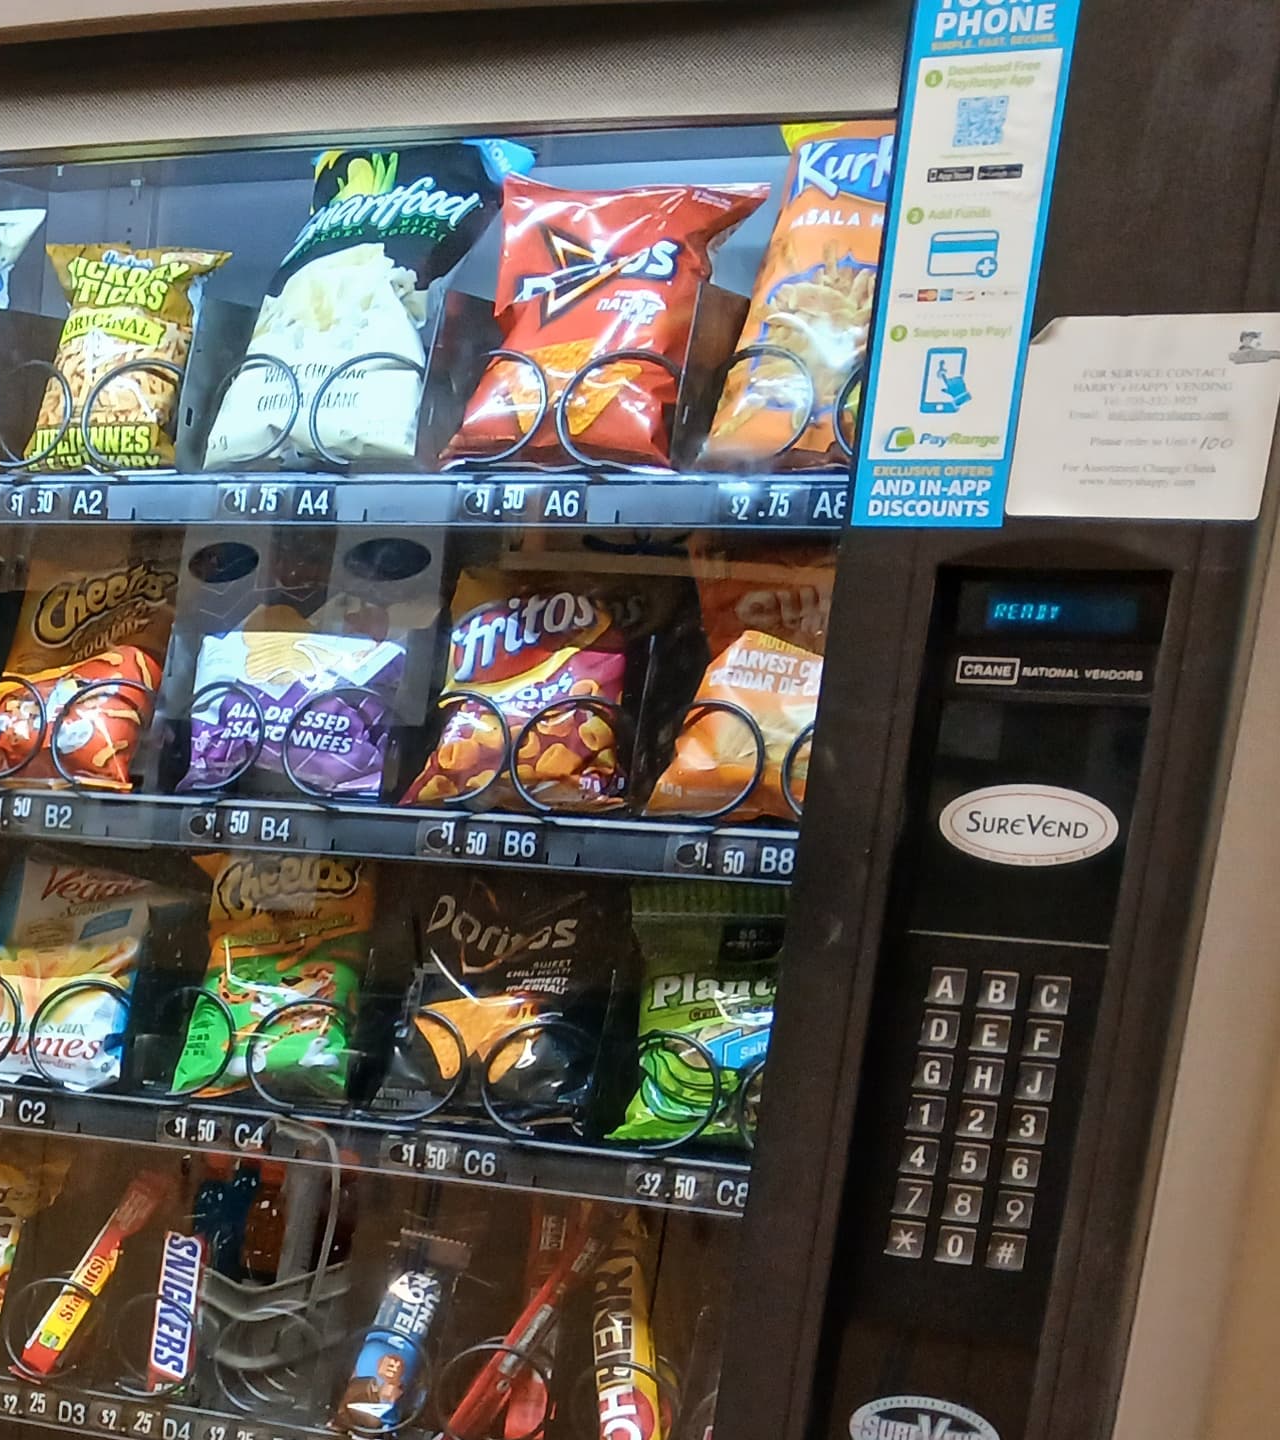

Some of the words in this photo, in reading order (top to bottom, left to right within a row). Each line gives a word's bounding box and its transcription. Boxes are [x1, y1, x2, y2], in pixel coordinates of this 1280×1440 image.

[935, 4, 1056, 38] PHONE
[64, 313, 151, 339] ORIGINAL
[970, 327, 983, 336] to
[919, 432, 1000, 447] PayRange
[873, 466, 940, 477] EXCLUSIVE
[944, 466, 994, 477] OFFERS
[871, 480, 916, 496] AND
[919, 479, 991, 496] IN-APP
[73, 489, 103, 515] A2
[297, 489, 329, 515] A4
[544, 489, 580, 518] A6
[868, 500, 989, 517] DISCOUNTS
[35, 565, 179, 644] Cheetos
[993, 603, 1061, 622] READY
[963, 664, 1013, 677] CRANE
[1021, 666, 1079, 680] NATIONAL
[1085, 669, 1144, 682] VENDORS
[45, 805, 72, 828] B2
[261, 817, 290, 842] B4
[504, 829, 536, 858] B6
[760, 847, 794, 875] B8
[935, 975, 953, 999] A
[987, 979, 1006, 1004] B
[1040, 984, 1059, 1009] C
[929, 1018, 948, 1042] D
[981, 1024, 999, 1046] E
[1032, 1028, 1051, 1051] F
[923, 1060, 941, 1085] G
[973, 1065, 992, 1089] H
[1026, 1071, 1043, 1094] J
[19, 1100, 46, 1124] C2
[918, 1103, 929, 1125] 1
[967, 1109, 985, 1132] 2
[1019, 1114, 1035, 1137] 3
[234, 1122, 264, 1149] C4
[464, 1150, 497, 1177] C6
[909, 1145, 926, 1167] 4
[961, 1151, 976, 1174] 5
[1011, 1157, 1028, 1180] 6
[905, 1187, 922, 1213] 7
[953, 1193, 972, 1217] 8
[1006, 1199, 1024, 1224] 9
[947, 1235, 964, 1257] 0
[996, 1241, 1016, 1264] #
[152, 1232, 203, 1378] SNICKERS
[58, 1401, 86, 1425] D3
